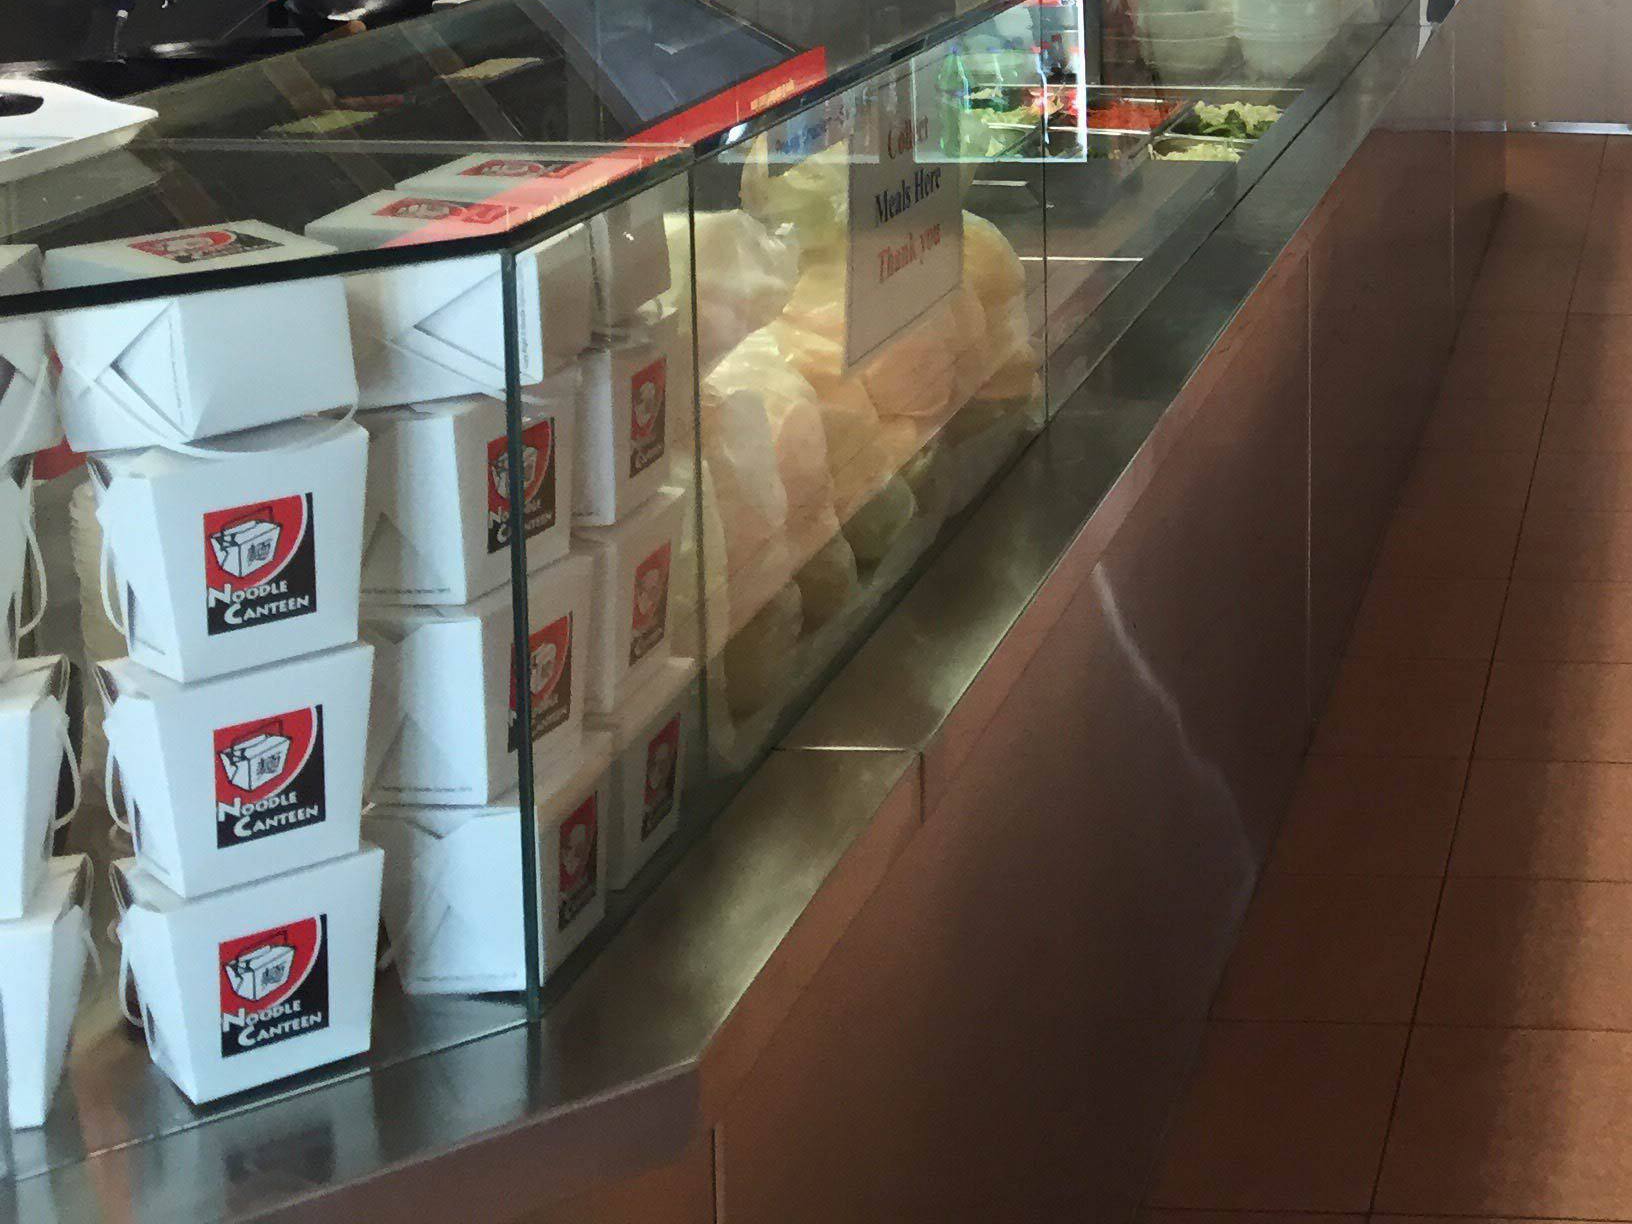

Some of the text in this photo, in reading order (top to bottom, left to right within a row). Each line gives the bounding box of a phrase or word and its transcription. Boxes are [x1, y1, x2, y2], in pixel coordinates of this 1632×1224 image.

[875, 167, 942, 225] Meals Here
[879, 224, 942, 284] Thank you
[208, 580, 289, 608] NOODLE
[224, 595, 310, 625] CANTEEN
[217, 791, 298, 822] NOODLE
[233, 804, 319, 838] CANTEEN
[222, 1000, 302, 1032] NOODLE
[238, 1011, 322, 1047] CANTEEN
